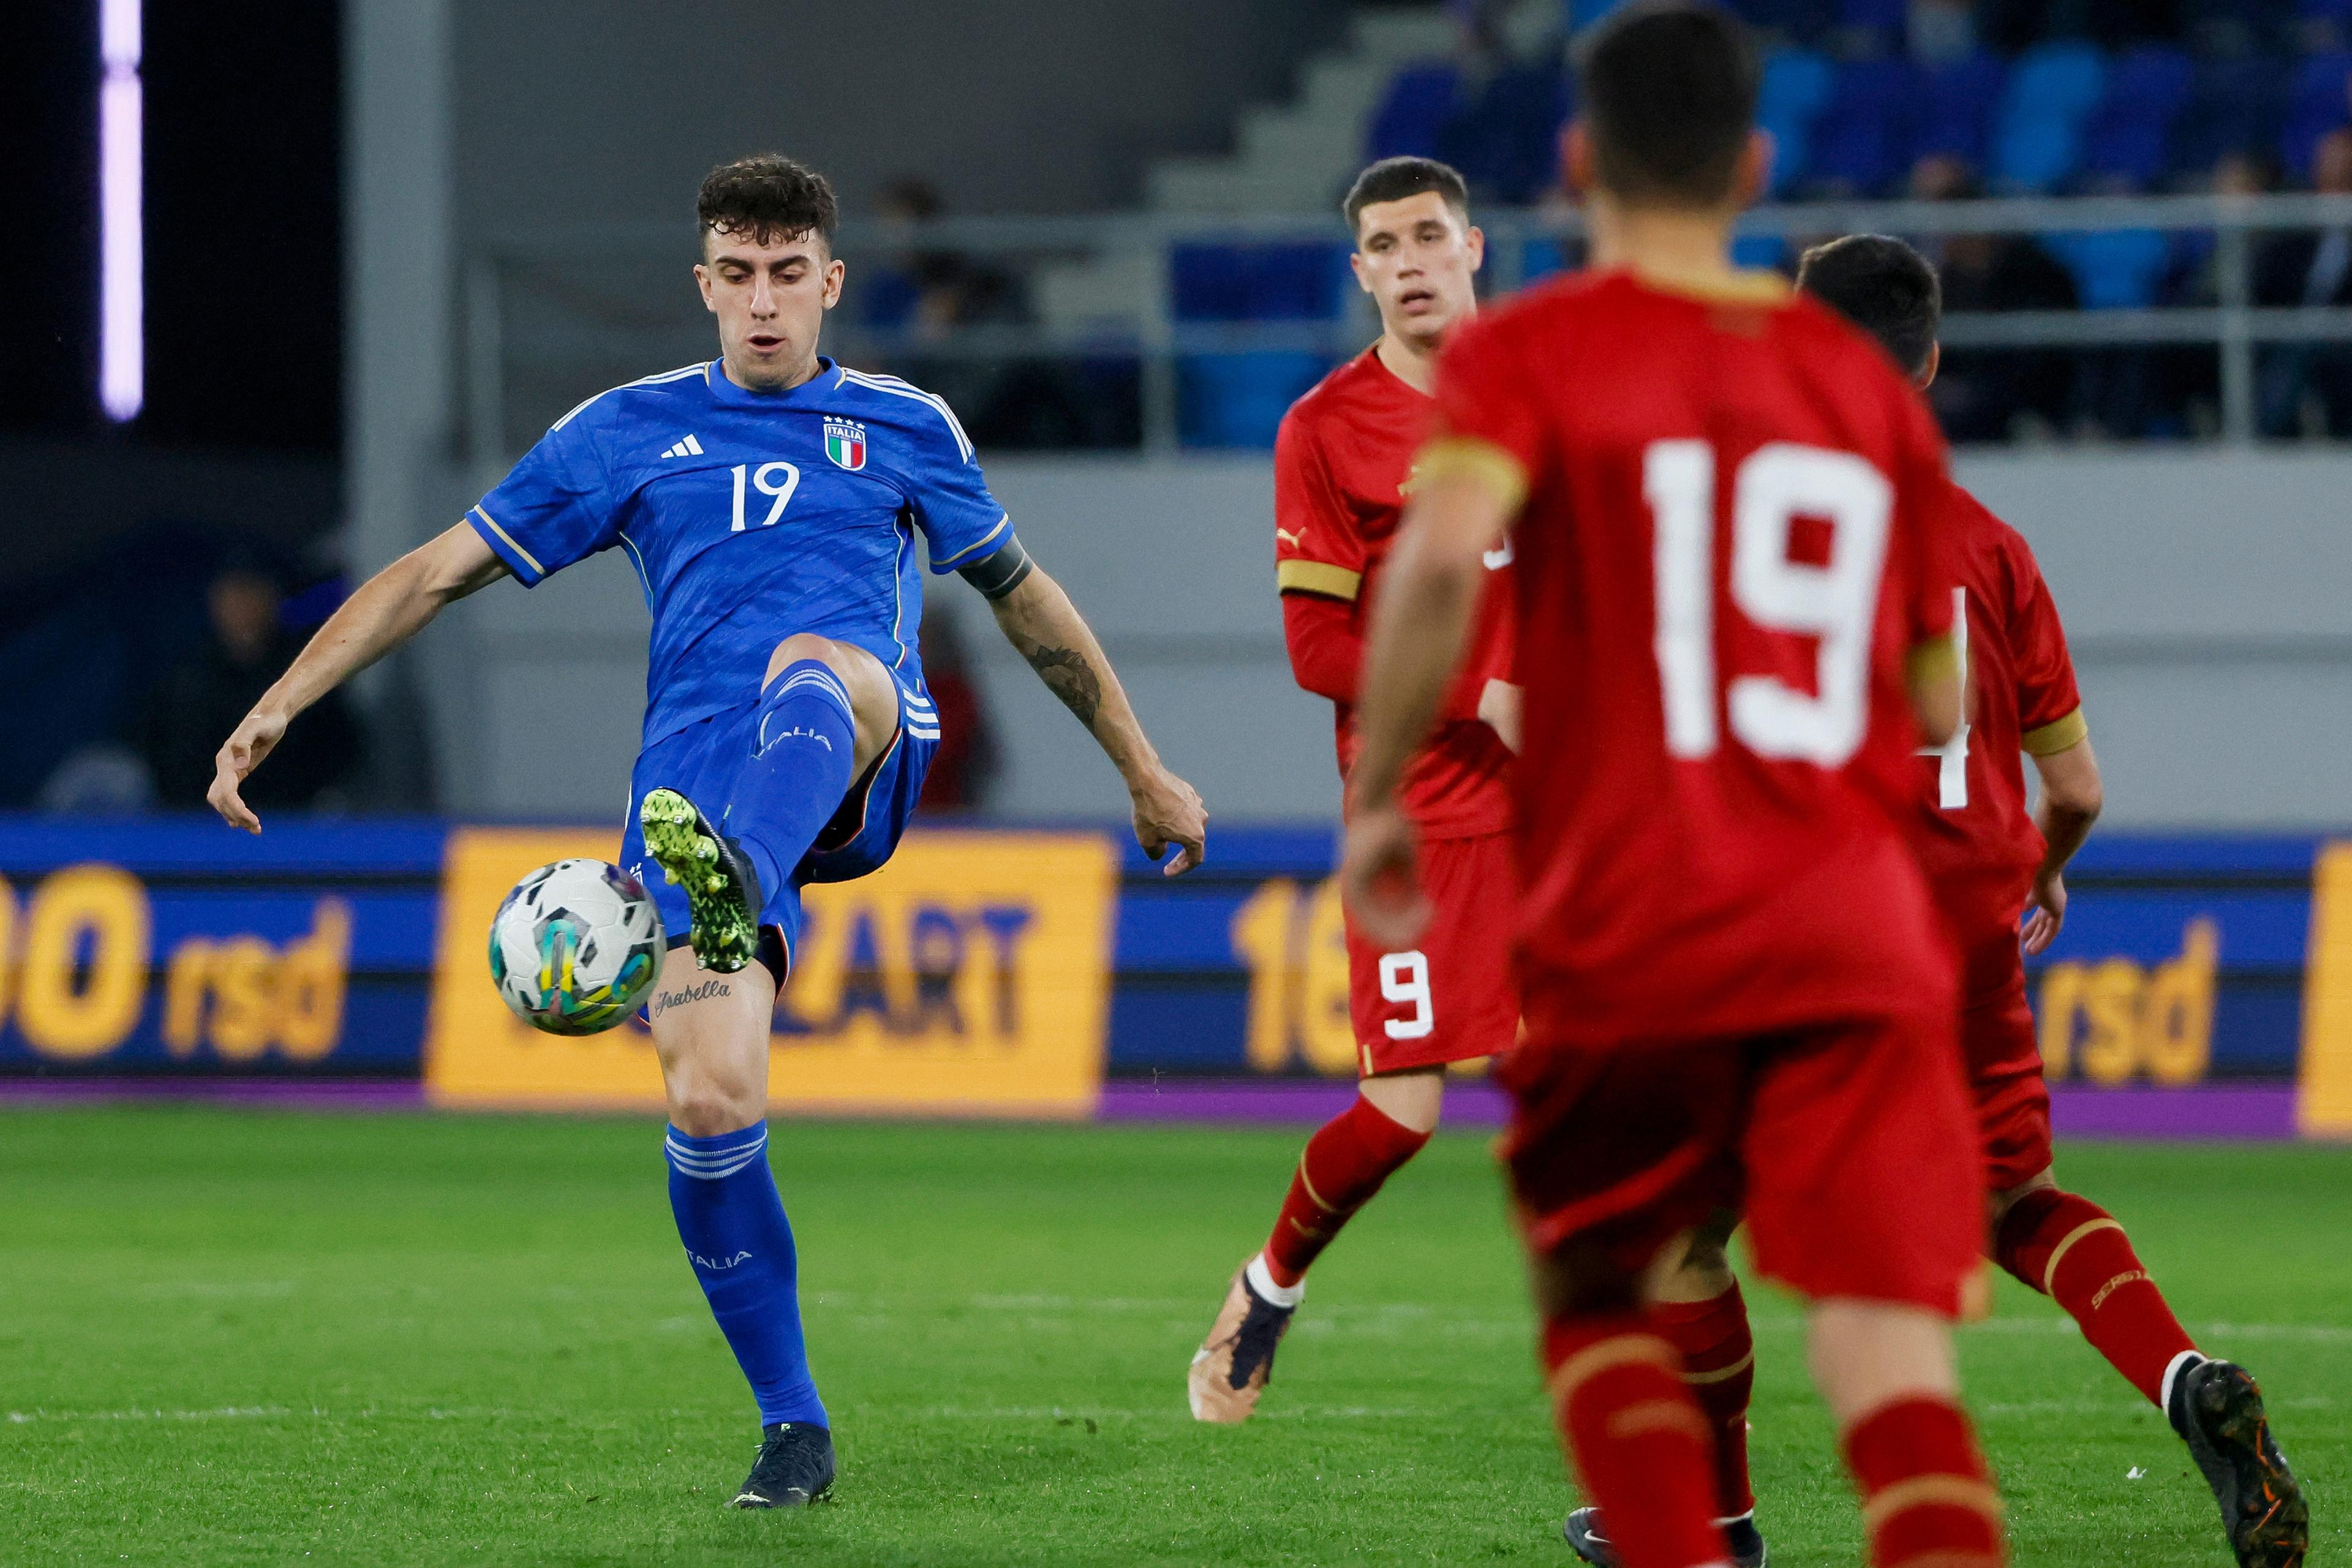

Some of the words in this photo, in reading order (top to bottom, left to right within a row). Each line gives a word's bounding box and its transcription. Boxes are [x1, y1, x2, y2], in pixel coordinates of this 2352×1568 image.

[827, 426, 862, 441] ITALIA
[731, 461, 800, 532] 19
[1643, 437, 1898, 771] 19
[0, 862, 152, 1058] 0
[160, 894, 353, 1060] rsd
[1379, 950, 1434, 1039] 9
[2038, 915, 2218, 1087] rsd
[683, 1245, 752, 1268] TALIA
